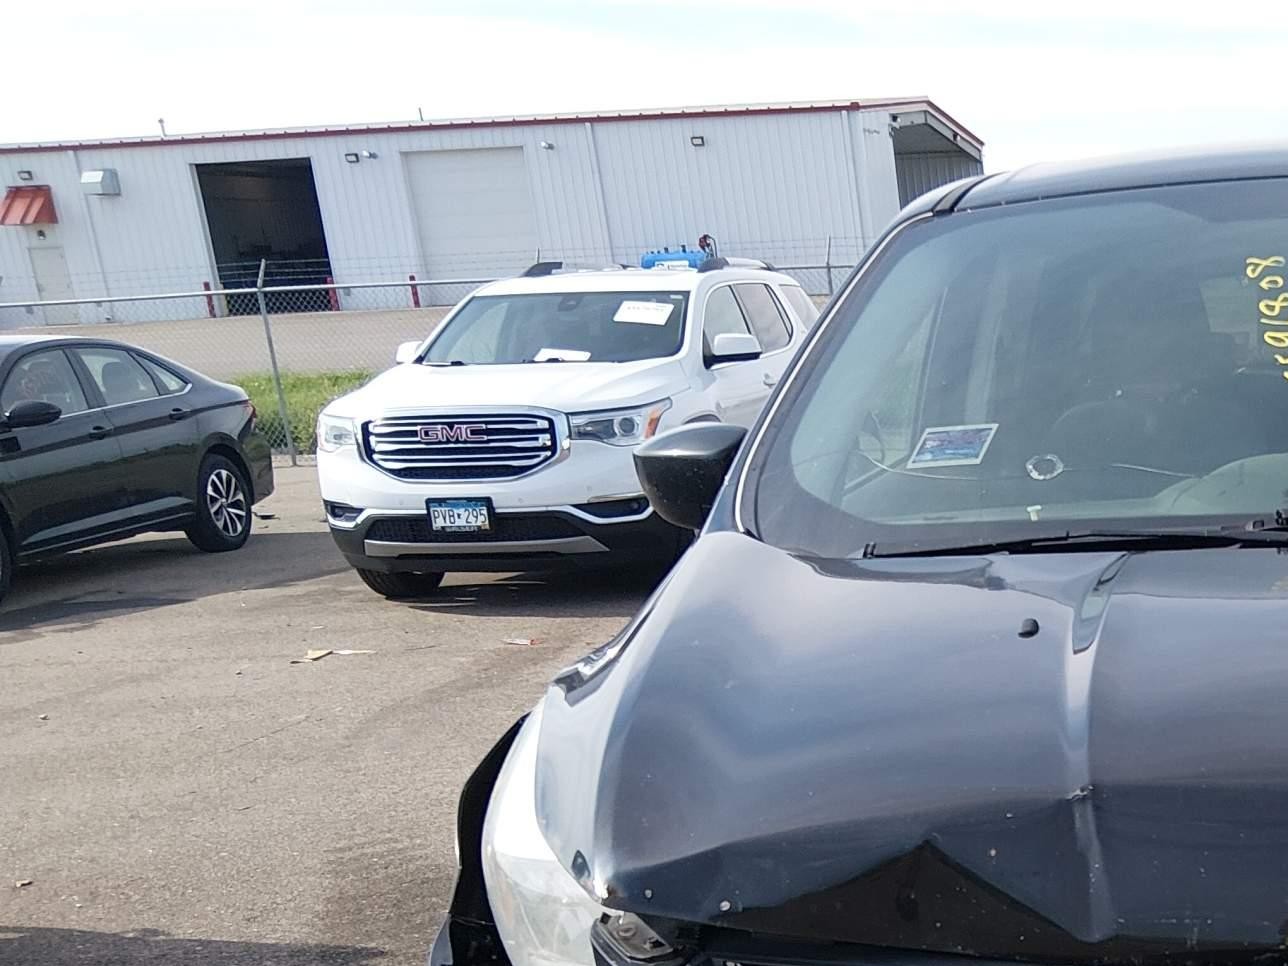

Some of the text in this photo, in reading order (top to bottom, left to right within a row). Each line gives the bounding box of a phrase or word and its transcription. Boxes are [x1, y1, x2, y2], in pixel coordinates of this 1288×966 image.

[417, 424, 488, 442] GMC
[432, 507, 487, 525] PVB 295
